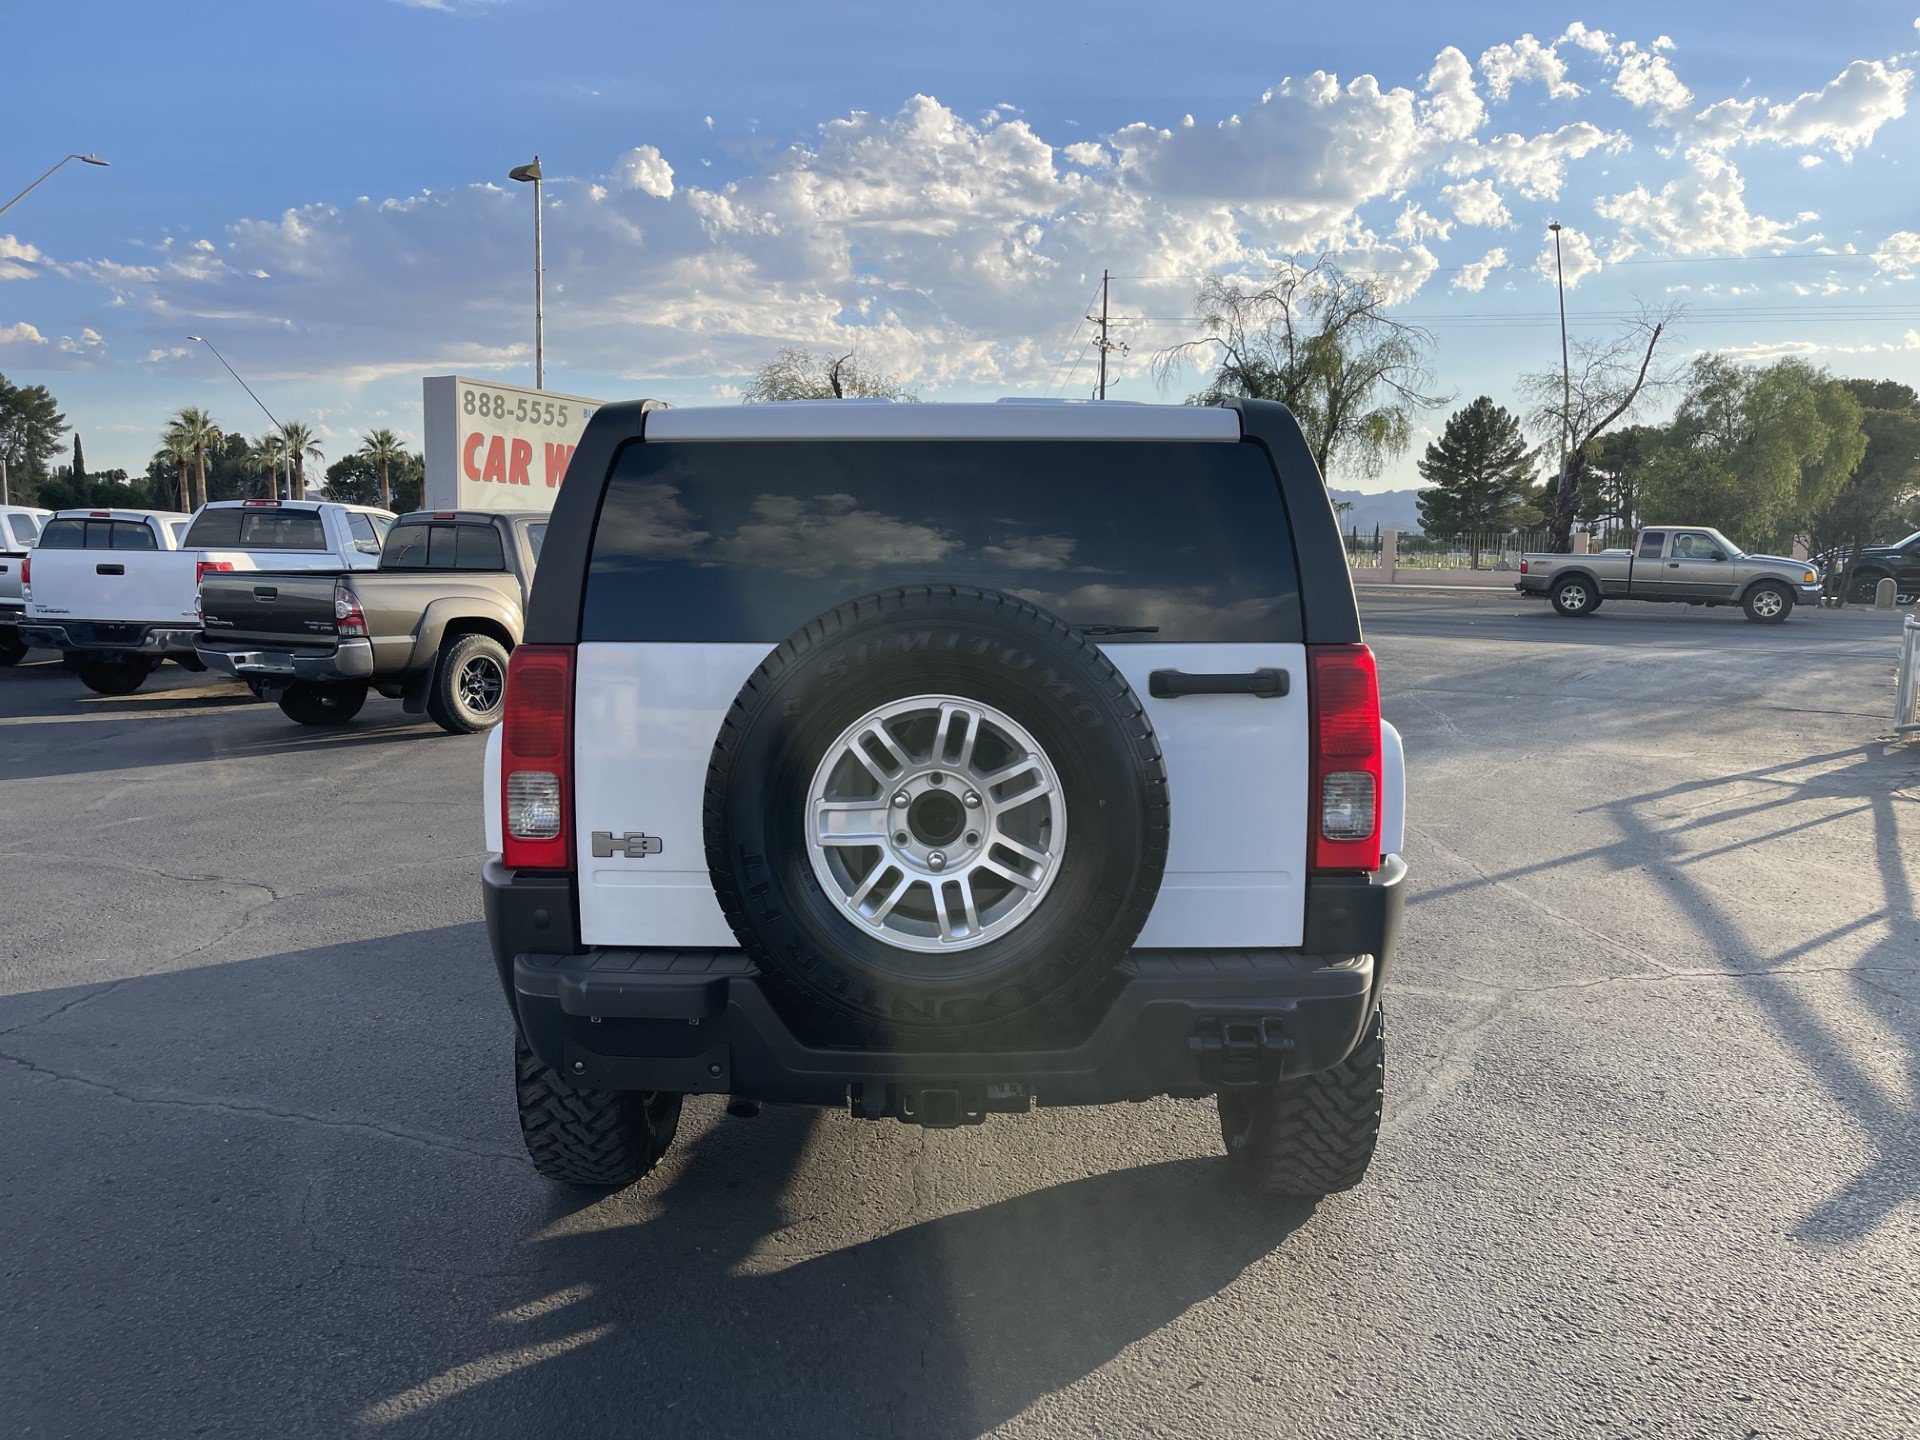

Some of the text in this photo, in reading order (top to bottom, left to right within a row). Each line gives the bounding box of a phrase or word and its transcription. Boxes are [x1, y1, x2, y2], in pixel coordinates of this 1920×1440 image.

[463, 390, 568, 428] 888-5555
[463, 432, 533, 485] CAR
[817, 629, 1105, 728] SUMITOMO
[591, 831, 662, 858] H3
